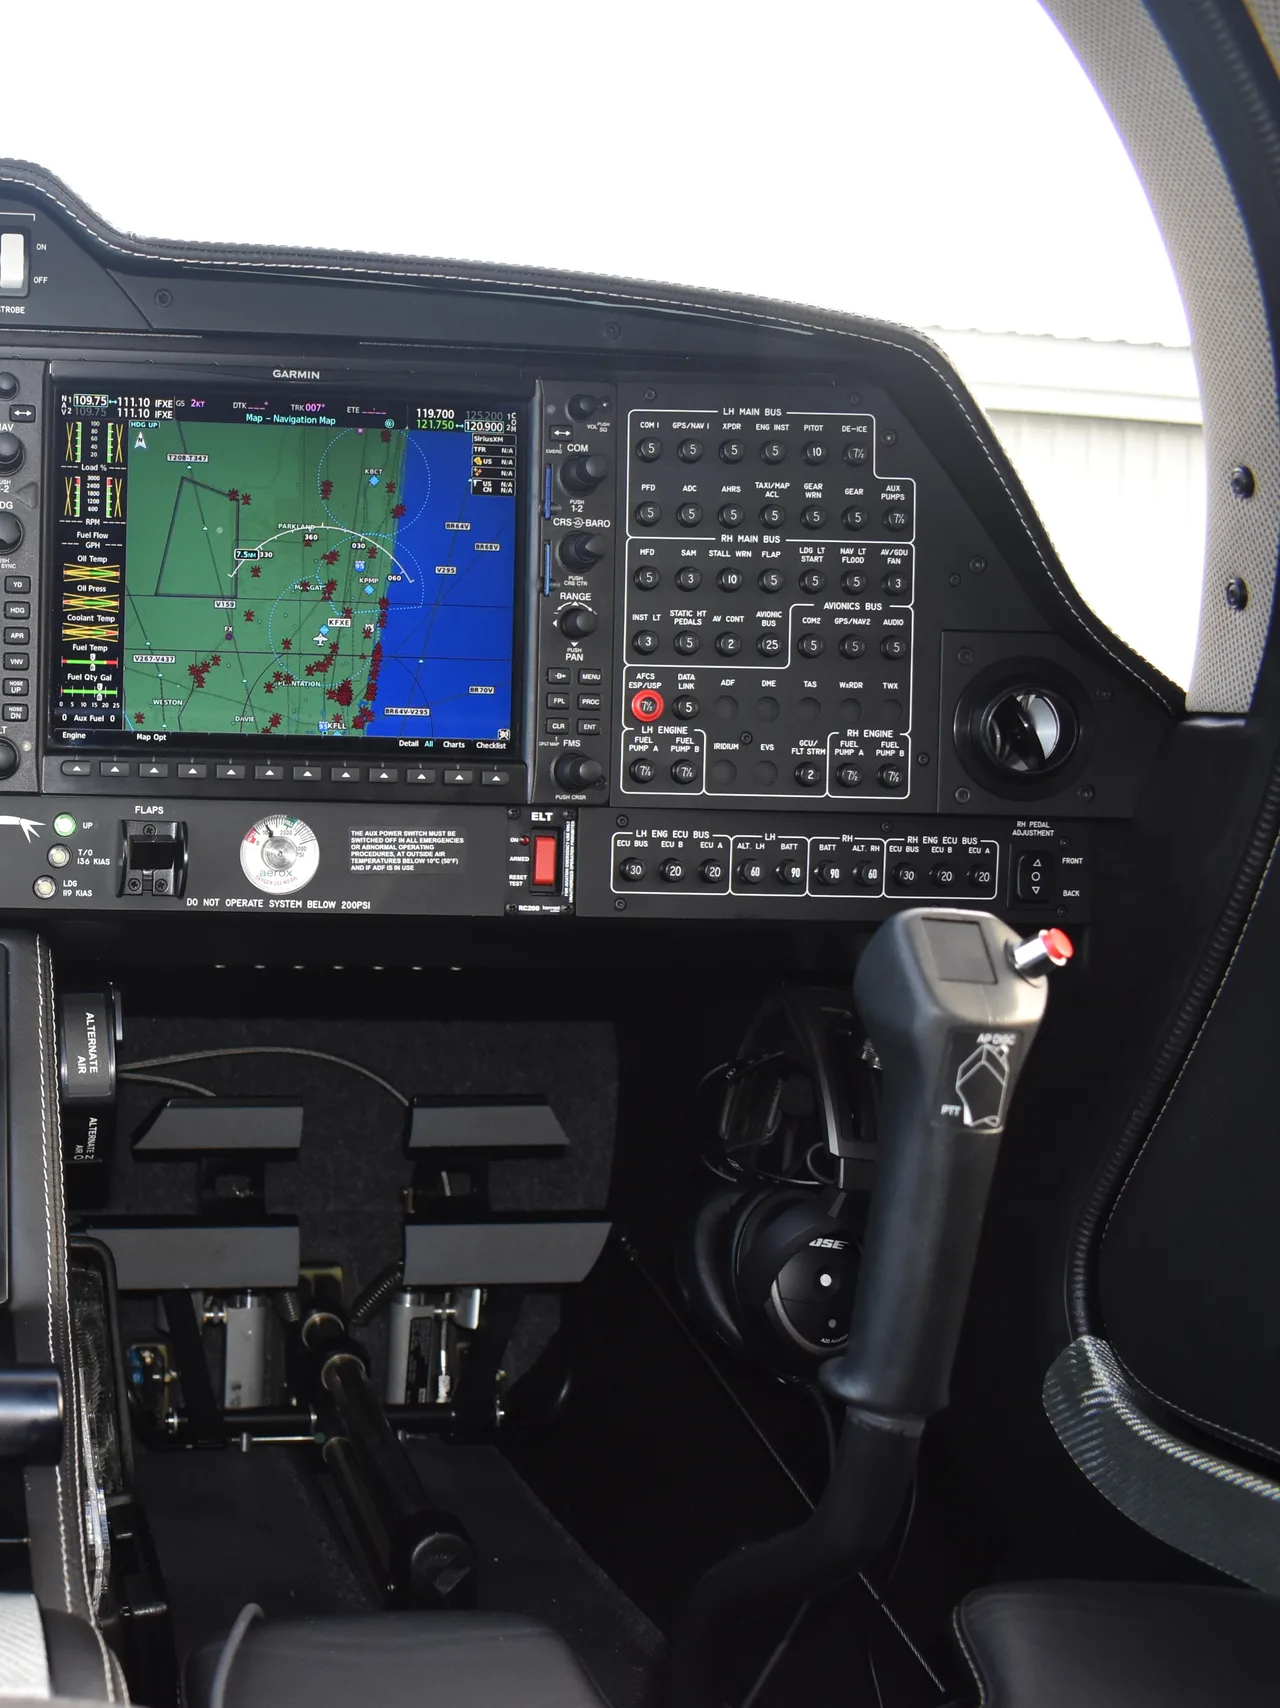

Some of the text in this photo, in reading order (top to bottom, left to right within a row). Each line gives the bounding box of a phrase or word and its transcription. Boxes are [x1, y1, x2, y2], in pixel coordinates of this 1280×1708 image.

[33, 276, 48, 284] OFF
[272, 369, 320, 379] GARMIN
[417, 408, 455, 419] 119.700
[723, 407, 734, 415] LH
[765, 408, 782, 416] BUS
[417, 419, 504, 433] 121.750 120.900
[721, 534, 780, 543] RH MAIN BUS
[823, 602, 882, 611] AVIONICS BUS
[97, 615, 115, 623] Temp
[641, 726, 688, 734] LH ENGINE
[847, 729, 893, 738] RH ENGINE
[62, 731, 86, 740] Engine
[137, 733, 166, 742] Map Opt
[135, 806, 164, 814] FLAPS
[531, 812, 553, 821] ELT
[652, 830, 668, 838] ENG
[673, 830, 688, 838] ECU
[693, 831, 709, 839] BUS
[259, 869, 293, 877] aerox
[187, 898, 370, 909] DO NOT OPERATE SYSTEM BELOW 200PSI
[86, 1012, 98, 1074] ALTERNATE
[77, 1056, 87, 1074] AIR
